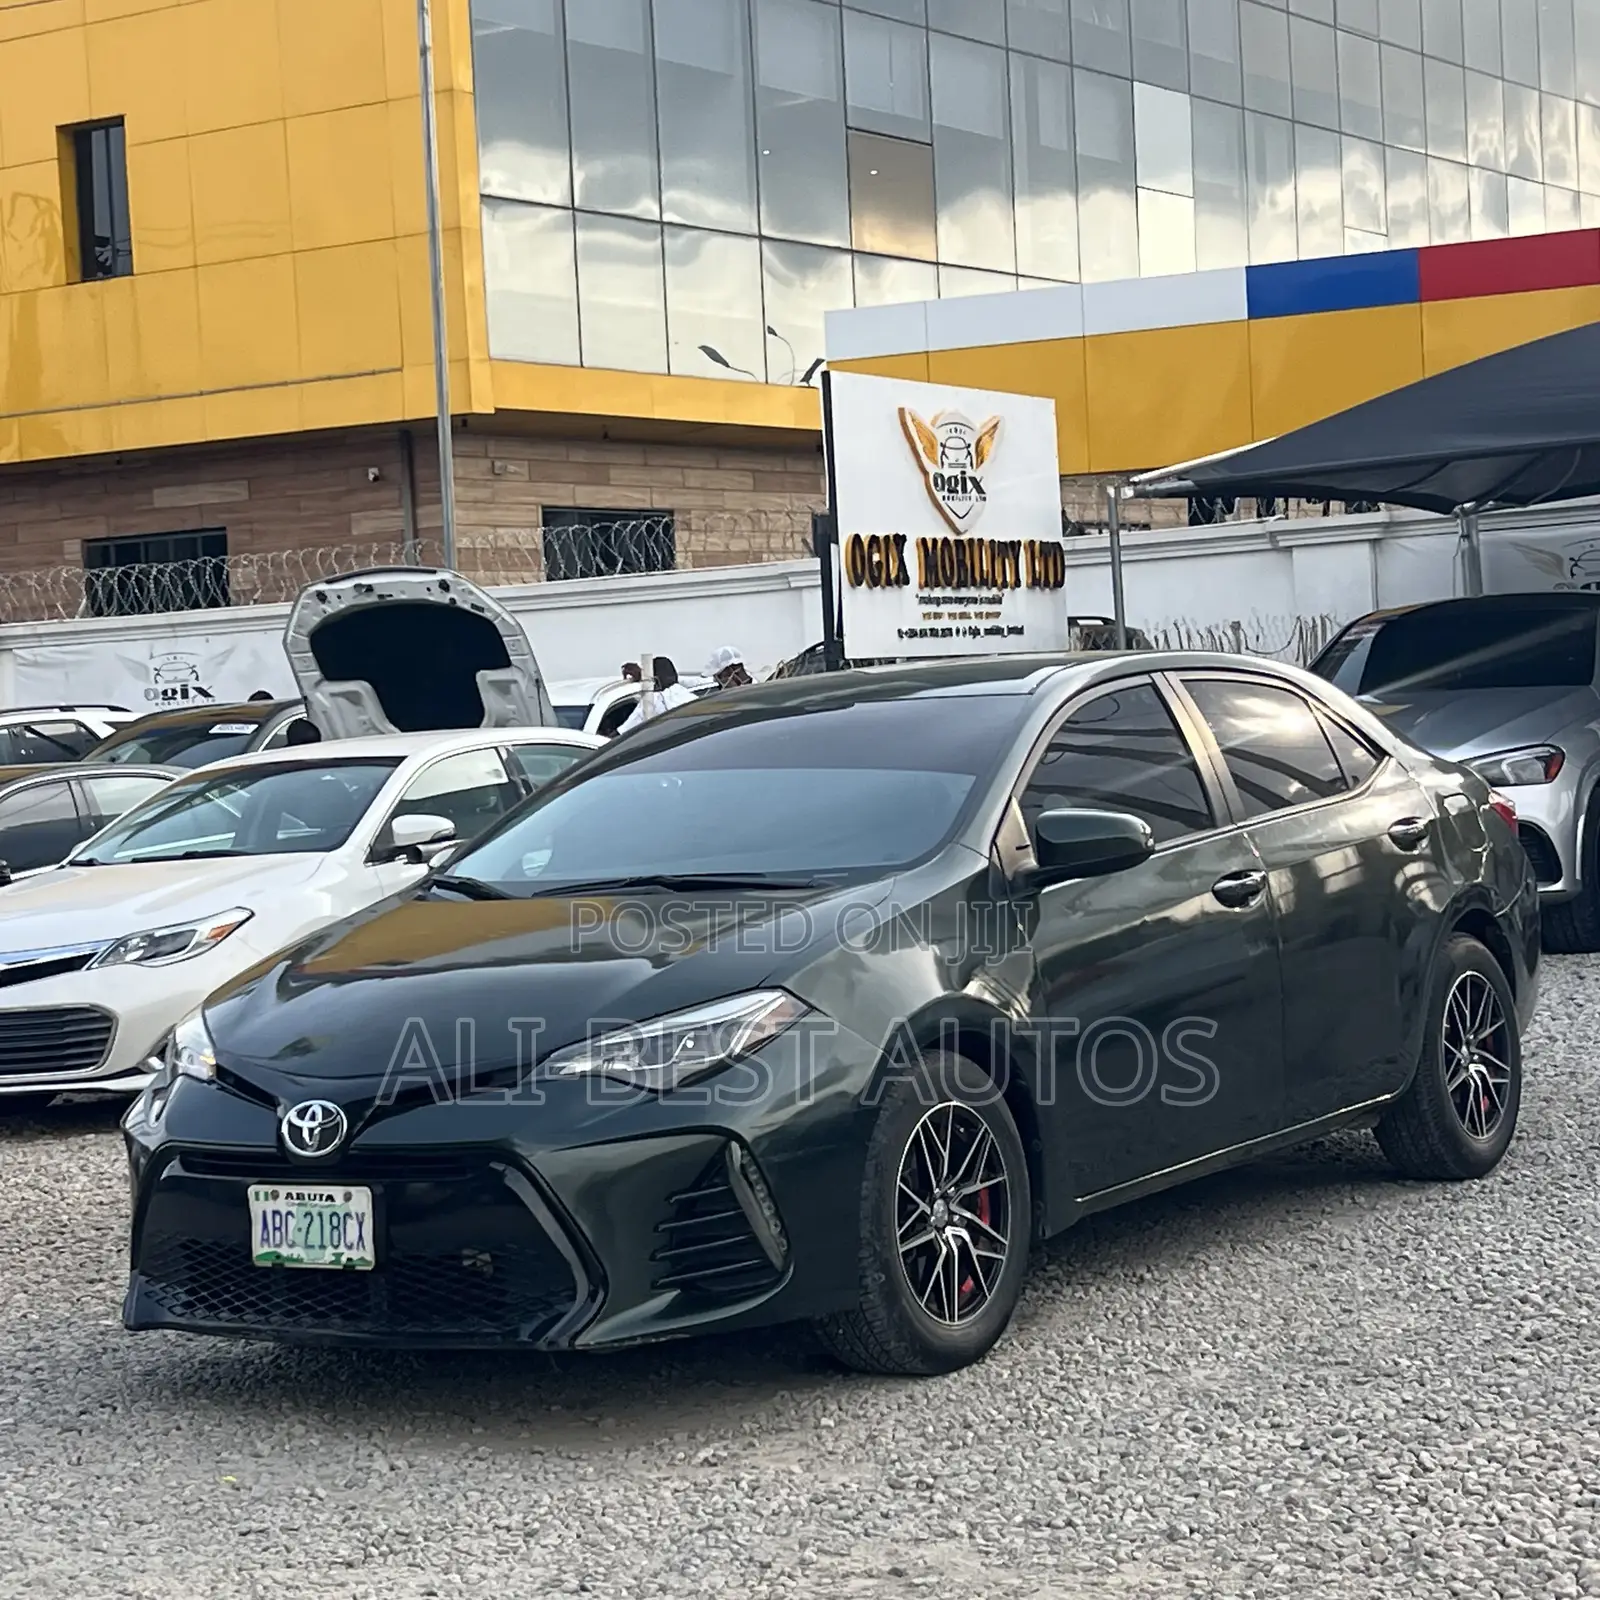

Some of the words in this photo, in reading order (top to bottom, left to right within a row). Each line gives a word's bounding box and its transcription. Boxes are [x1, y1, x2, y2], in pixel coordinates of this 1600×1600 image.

[845, 532, 911, 589] OGIX
[915, 536, 1022, 590] MOBILITY
[1023, 539, 1066, 590] LTD
[284, 1191, 336, 1203] ABUJA
